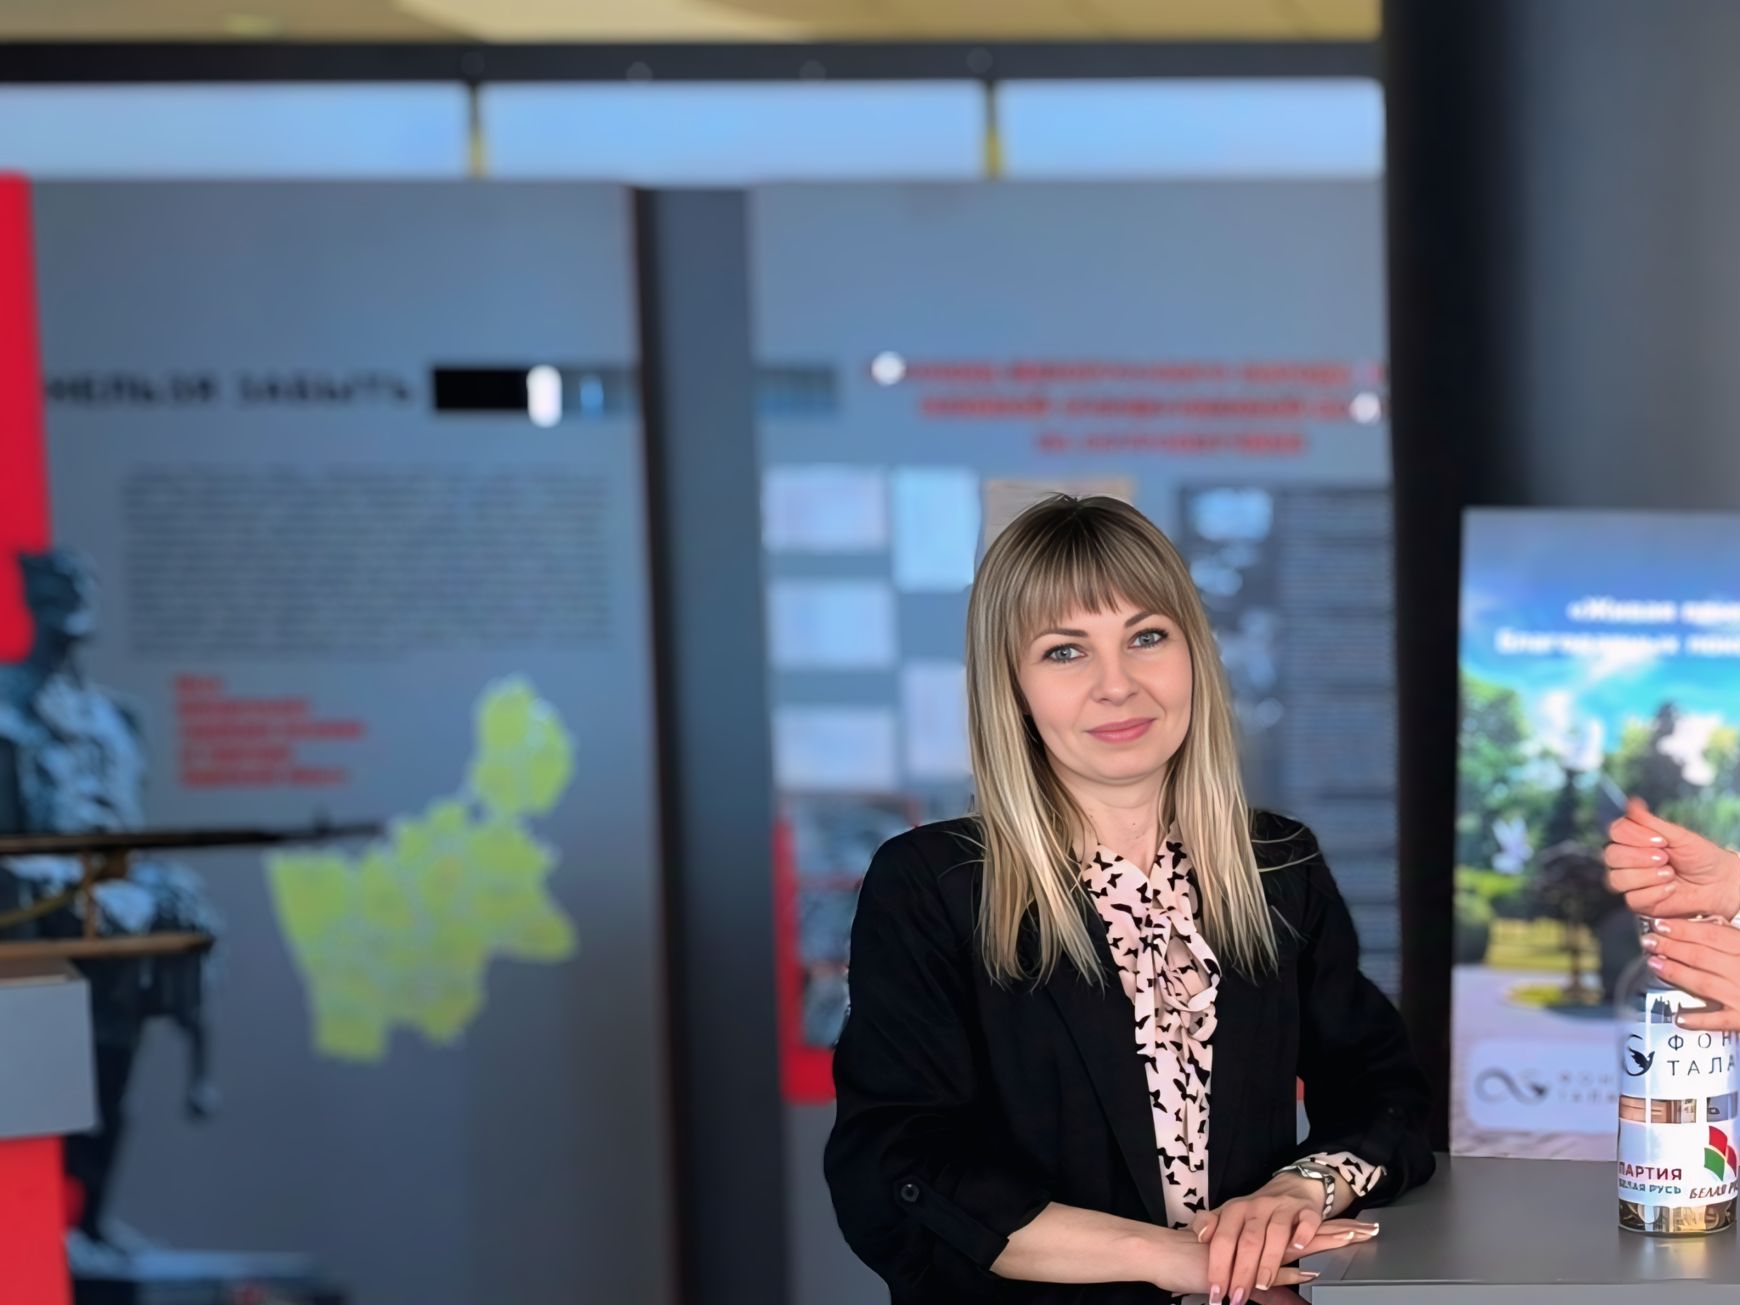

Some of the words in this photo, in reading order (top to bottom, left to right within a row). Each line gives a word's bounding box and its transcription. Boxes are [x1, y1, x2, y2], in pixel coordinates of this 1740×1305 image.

[1668, 1030, 1739, 1051] ФОН
[1619, 1161, 1682, 1181] ПАРТИЯ
[1649, 1184, 1682, 1194] РУСЬ
